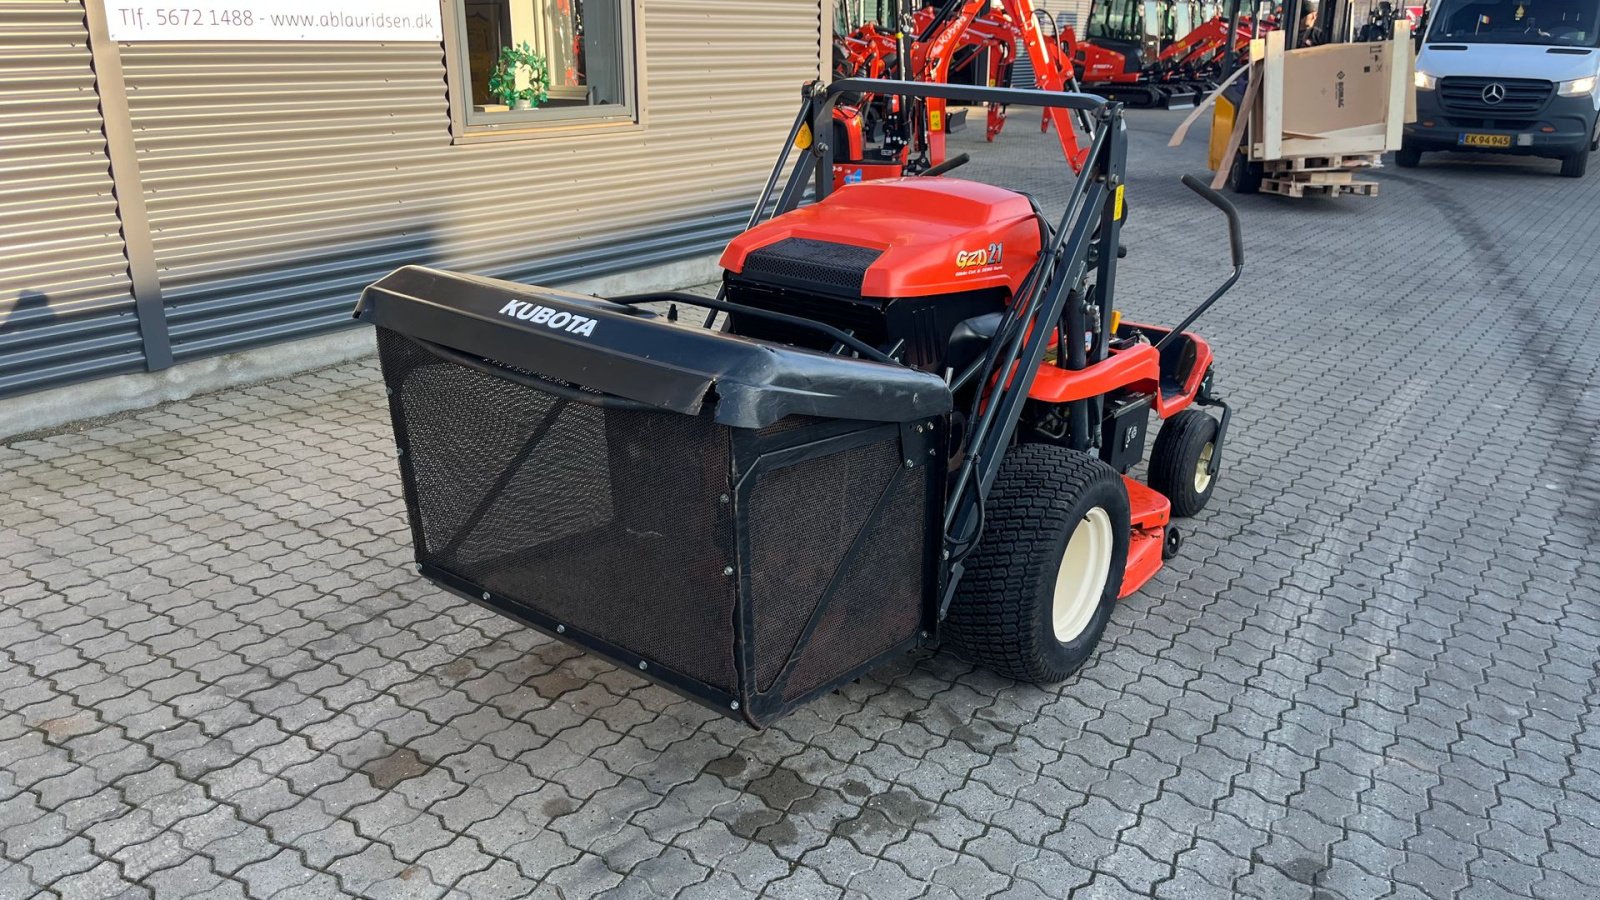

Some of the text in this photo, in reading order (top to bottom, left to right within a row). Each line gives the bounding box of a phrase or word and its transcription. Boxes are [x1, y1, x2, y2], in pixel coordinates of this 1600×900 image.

[118, 7, 150, 30] Tlf.
[156, 8, 204, 26] 5672
[210, 9, 254, 26] 1488
[270, 11, 433, 29] www.ablauridsen.dk
[1465, 134, 1476, 144] EK
[498, 299, 598, 337] KUBOTA
